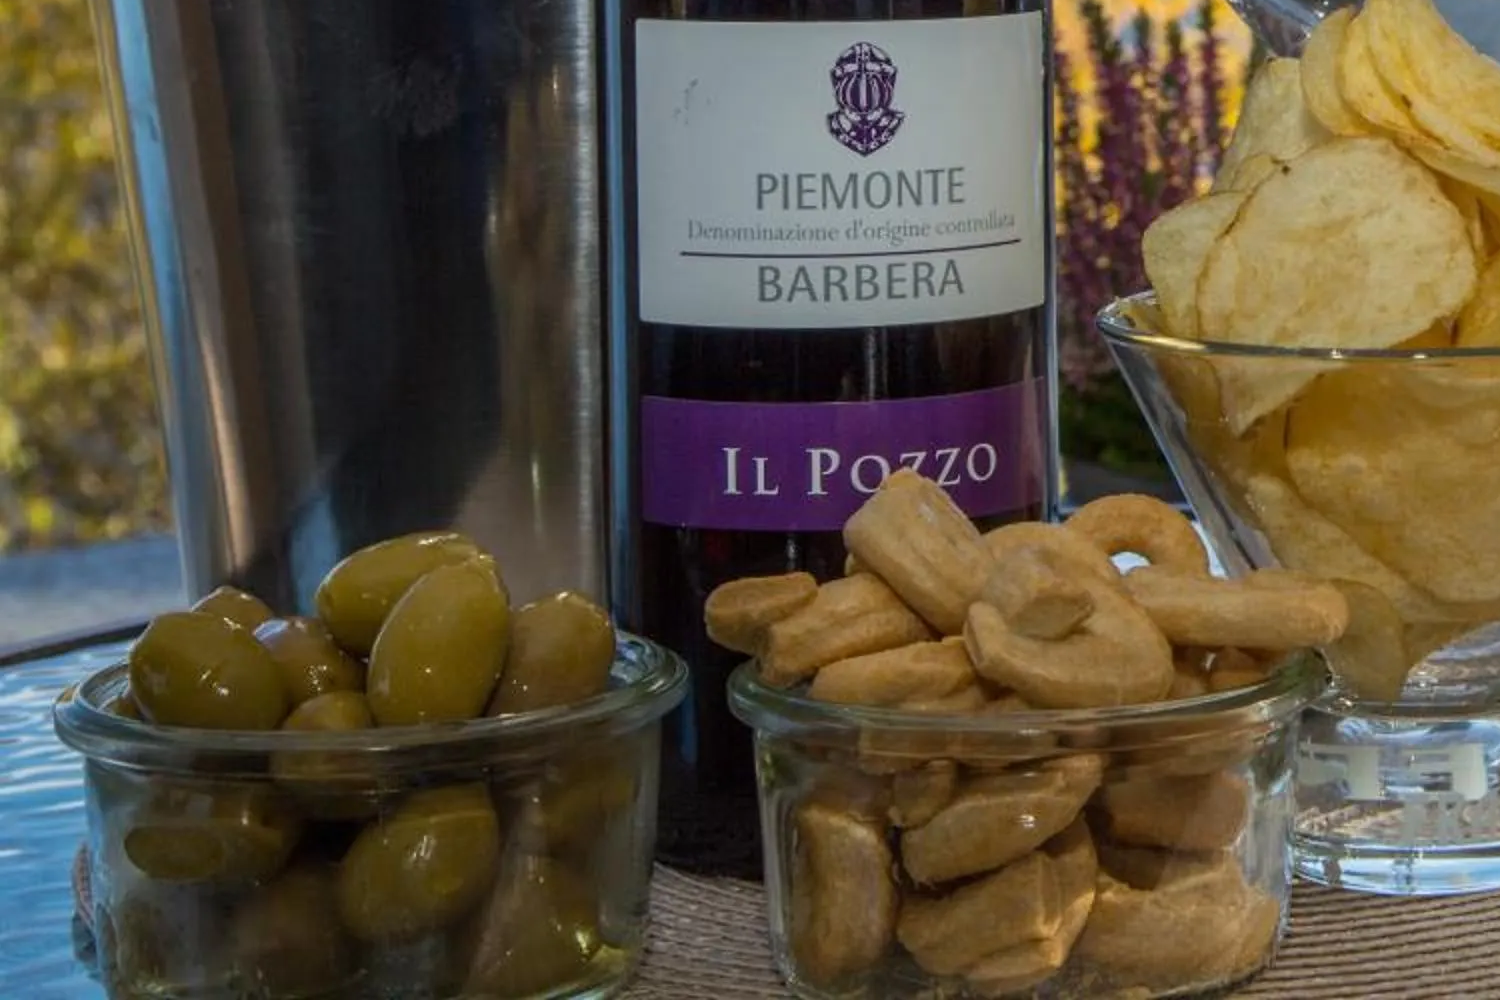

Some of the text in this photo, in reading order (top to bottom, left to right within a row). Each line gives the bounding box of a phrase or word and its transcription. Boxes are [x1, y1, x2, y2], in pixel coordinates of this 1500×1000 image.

[756, 168, 965, 211] PIEMONTE
[688, 219, 840, 242] Denominazione
[845, 219, 931, 247] d'origine
[758, 259, 965, 303] BARBERA
[721, 442, 998, 496] IL POZZO
